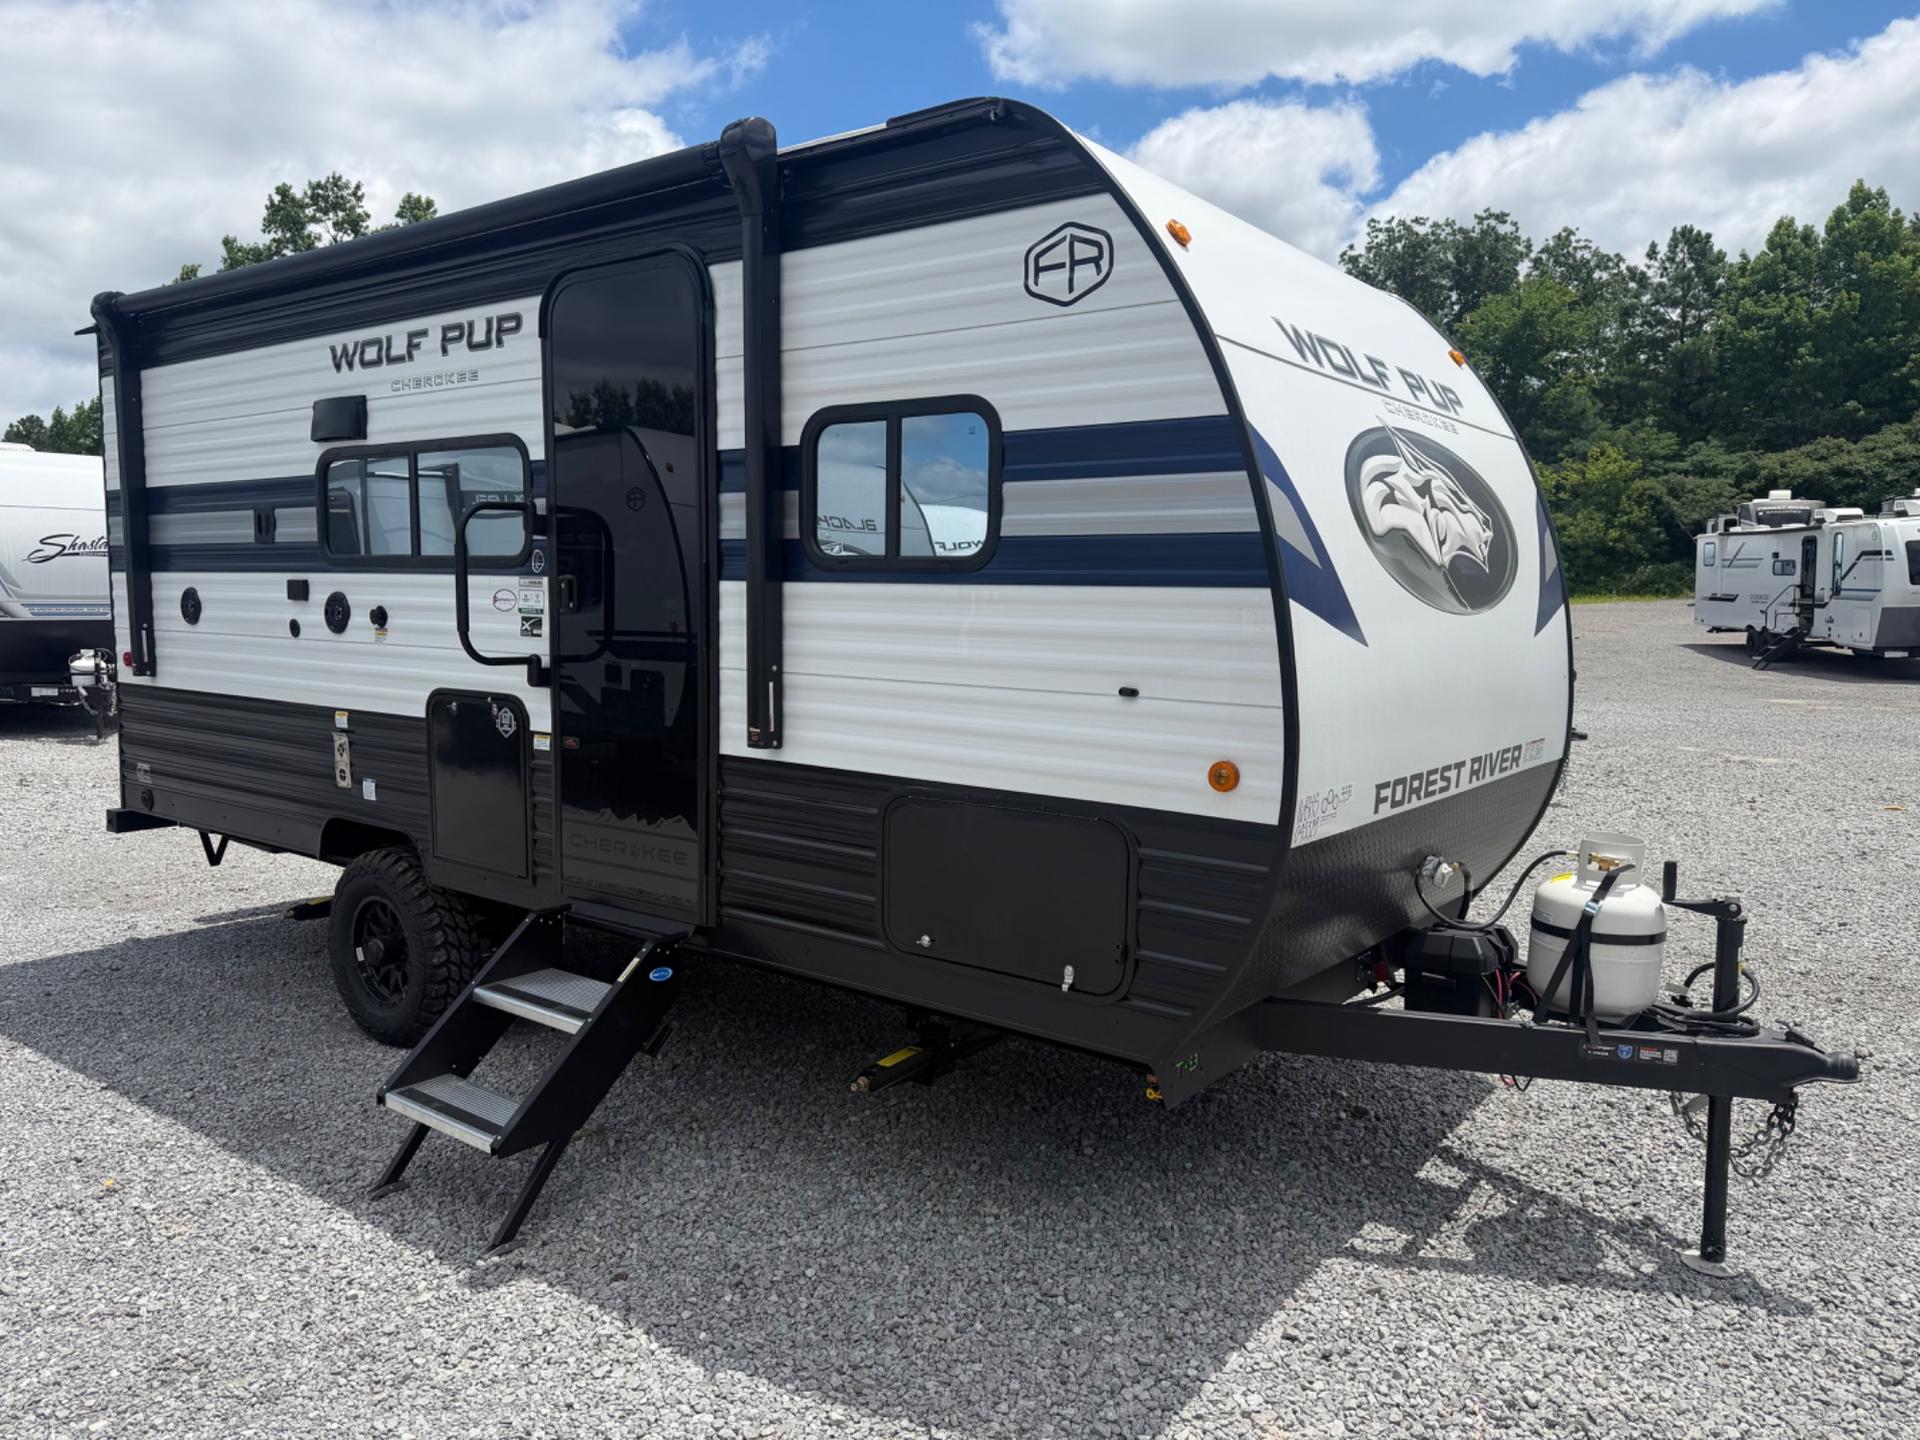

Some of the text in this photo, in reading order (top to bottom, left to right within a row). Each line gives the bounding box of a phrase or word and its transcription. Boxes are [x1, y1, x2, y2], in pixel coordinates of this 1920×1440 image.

[329, 311, 523, 374] WOLF PUP
[1270, 315, 1464, 416] WOLF PUP
[390, 369, 479, 392] CHEROKEE
[1373, 759, 1467, 815] FOREST
[1468, 743, 1523, 785] RIVER
